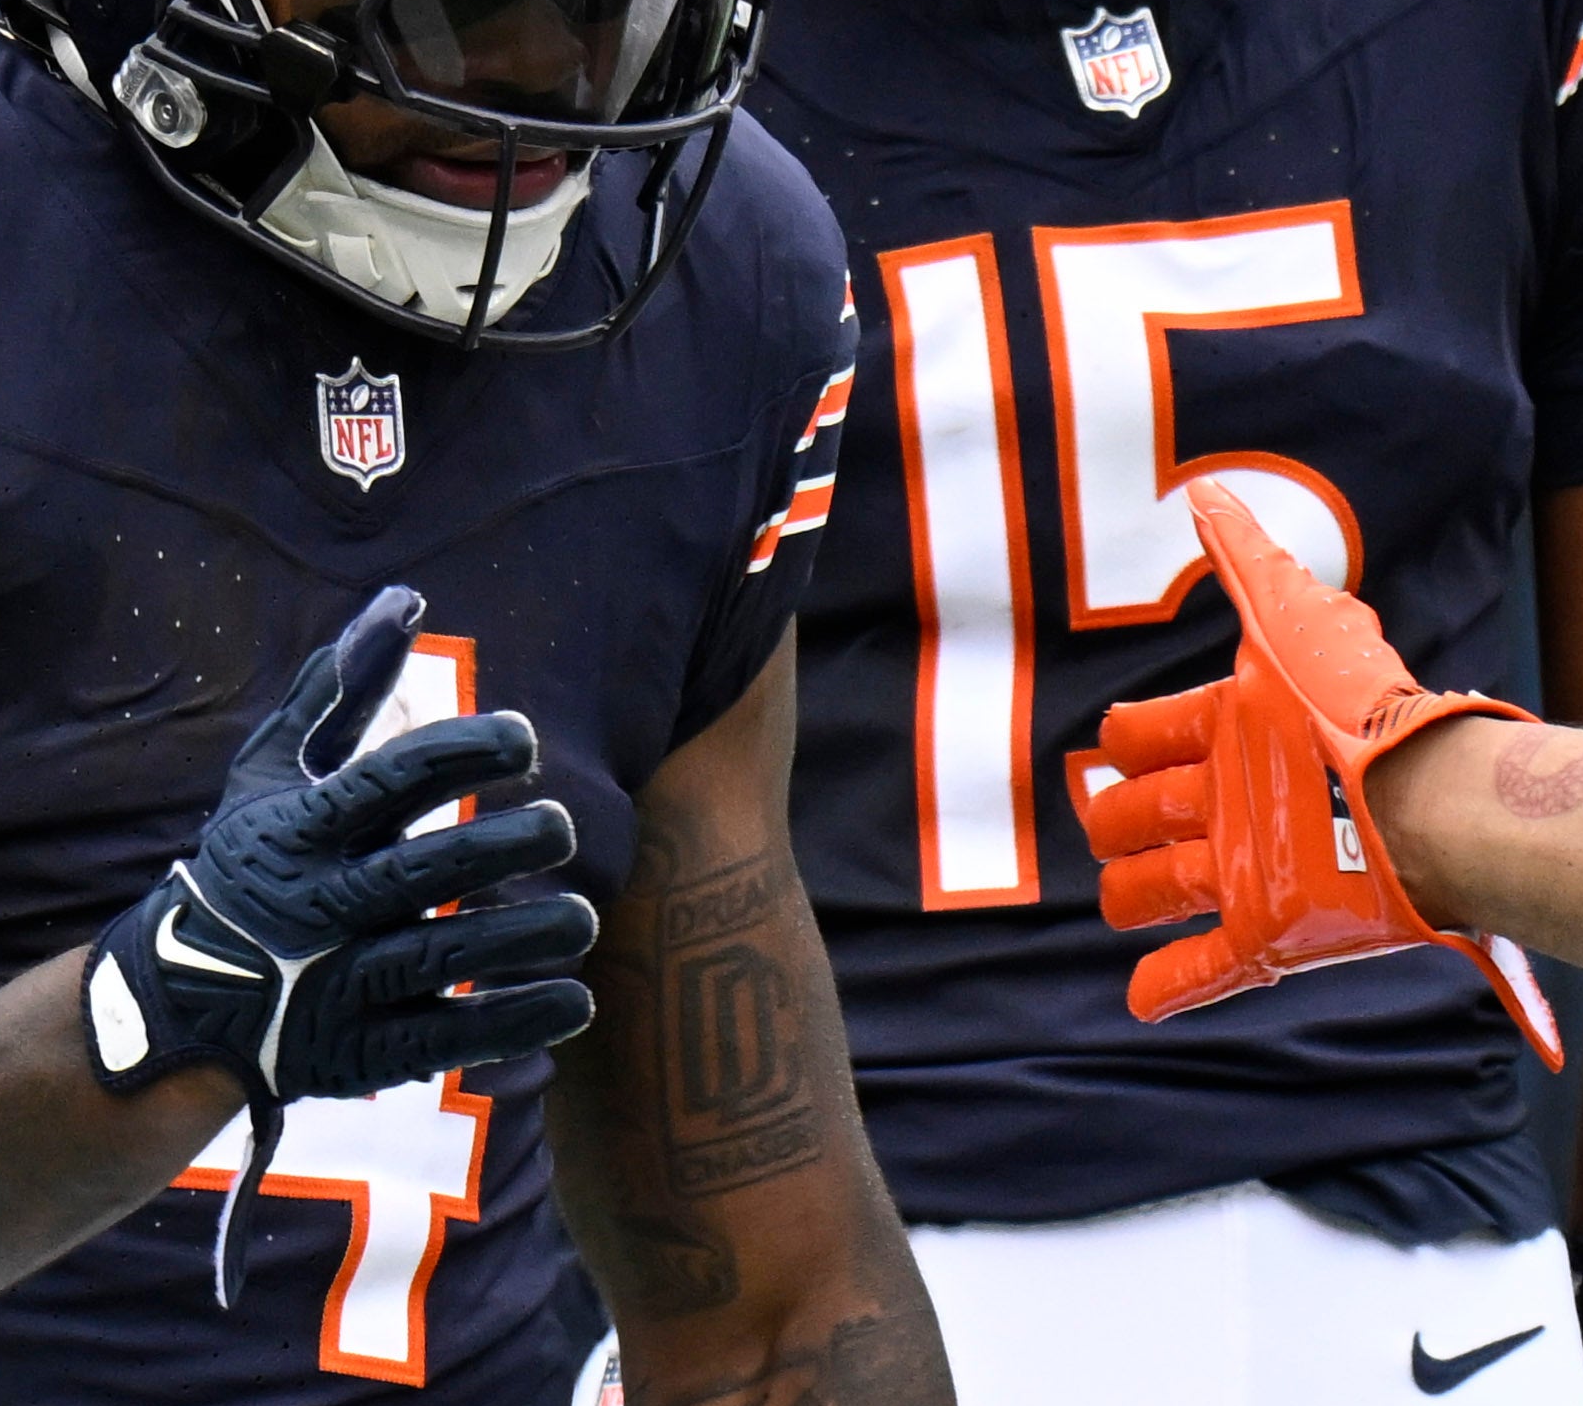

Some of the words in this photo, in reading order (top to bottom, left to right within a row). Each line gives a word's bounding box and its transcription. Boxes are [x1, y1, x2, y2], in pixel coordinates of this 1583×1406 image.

[1088, 51, 1153, 95] NFL
[334, 418, 392, 465] NFL
[878, 200, 1364, 912] 15
[170, 632, 493, 1388] 4
